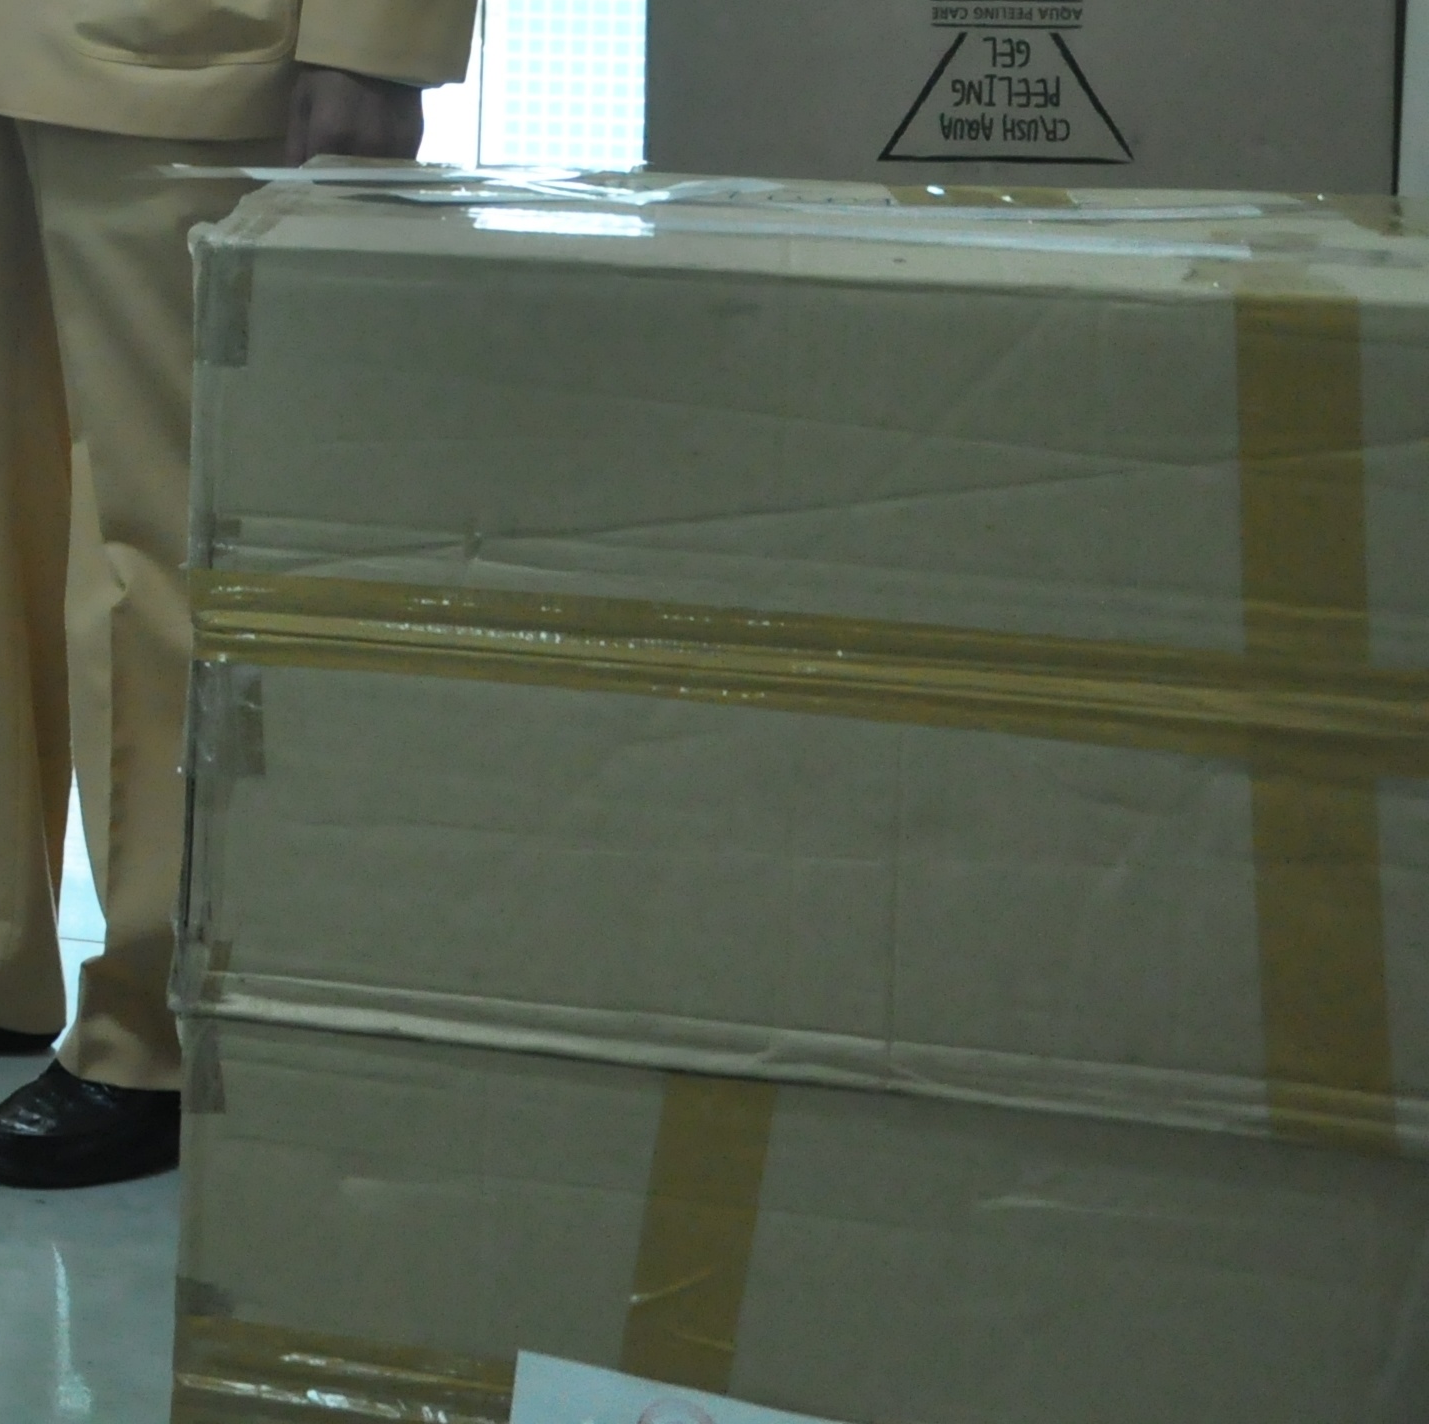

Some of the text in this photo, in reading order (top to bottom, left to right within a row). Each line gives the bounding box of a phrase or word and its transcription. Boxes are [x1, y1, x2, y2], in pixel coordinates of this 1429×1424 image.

[931, 6, 1083, 20] AQUA PEELING CARE
[982, 36, 1031, 68] GEL
[951, 74, 1060, 109] PEELING
[939, 112, 1071, 142] CRUSH AQUA
